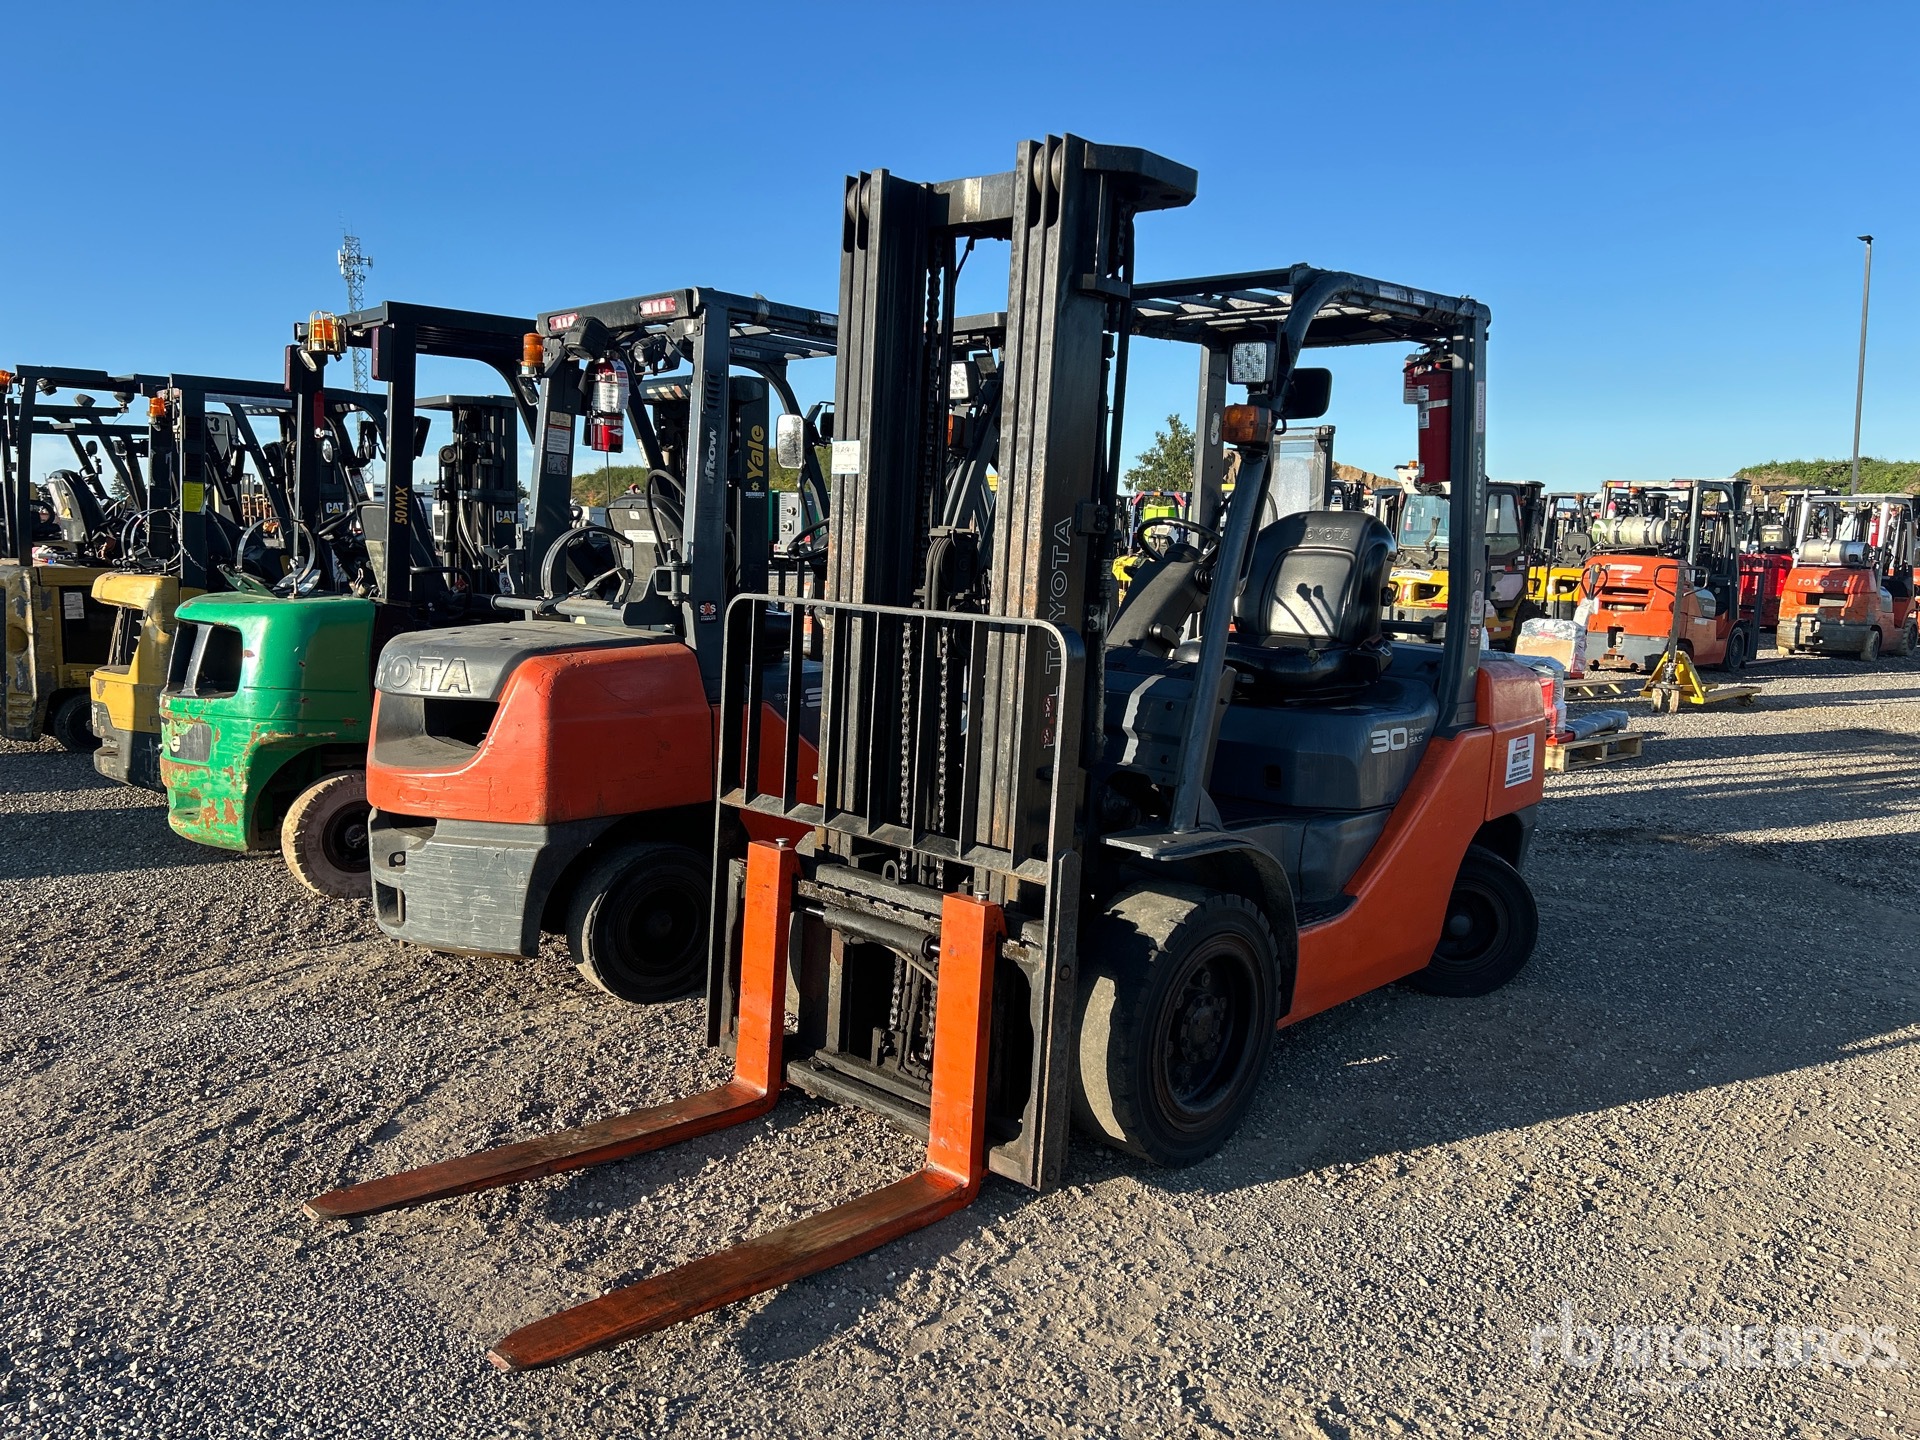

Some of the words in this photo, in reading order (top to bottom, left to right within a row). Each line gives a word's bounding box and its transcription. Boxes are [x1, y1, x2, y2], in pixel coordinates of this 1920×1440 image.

[747, 425, 765, 479] Yale
[326, 502, 344, 514] CAT
[395, 485, 408, 525] 50MX
[496, 510, 516, 523] CAT
[1305, 526, 1352, 541] OYOTA
[1797, 578, 1850, 588] TOYOTA
[385, 654, 471, 694] OTA
[1371, 727, 1408, 754] 30
[1409, 735, 1423, 745] SAS
